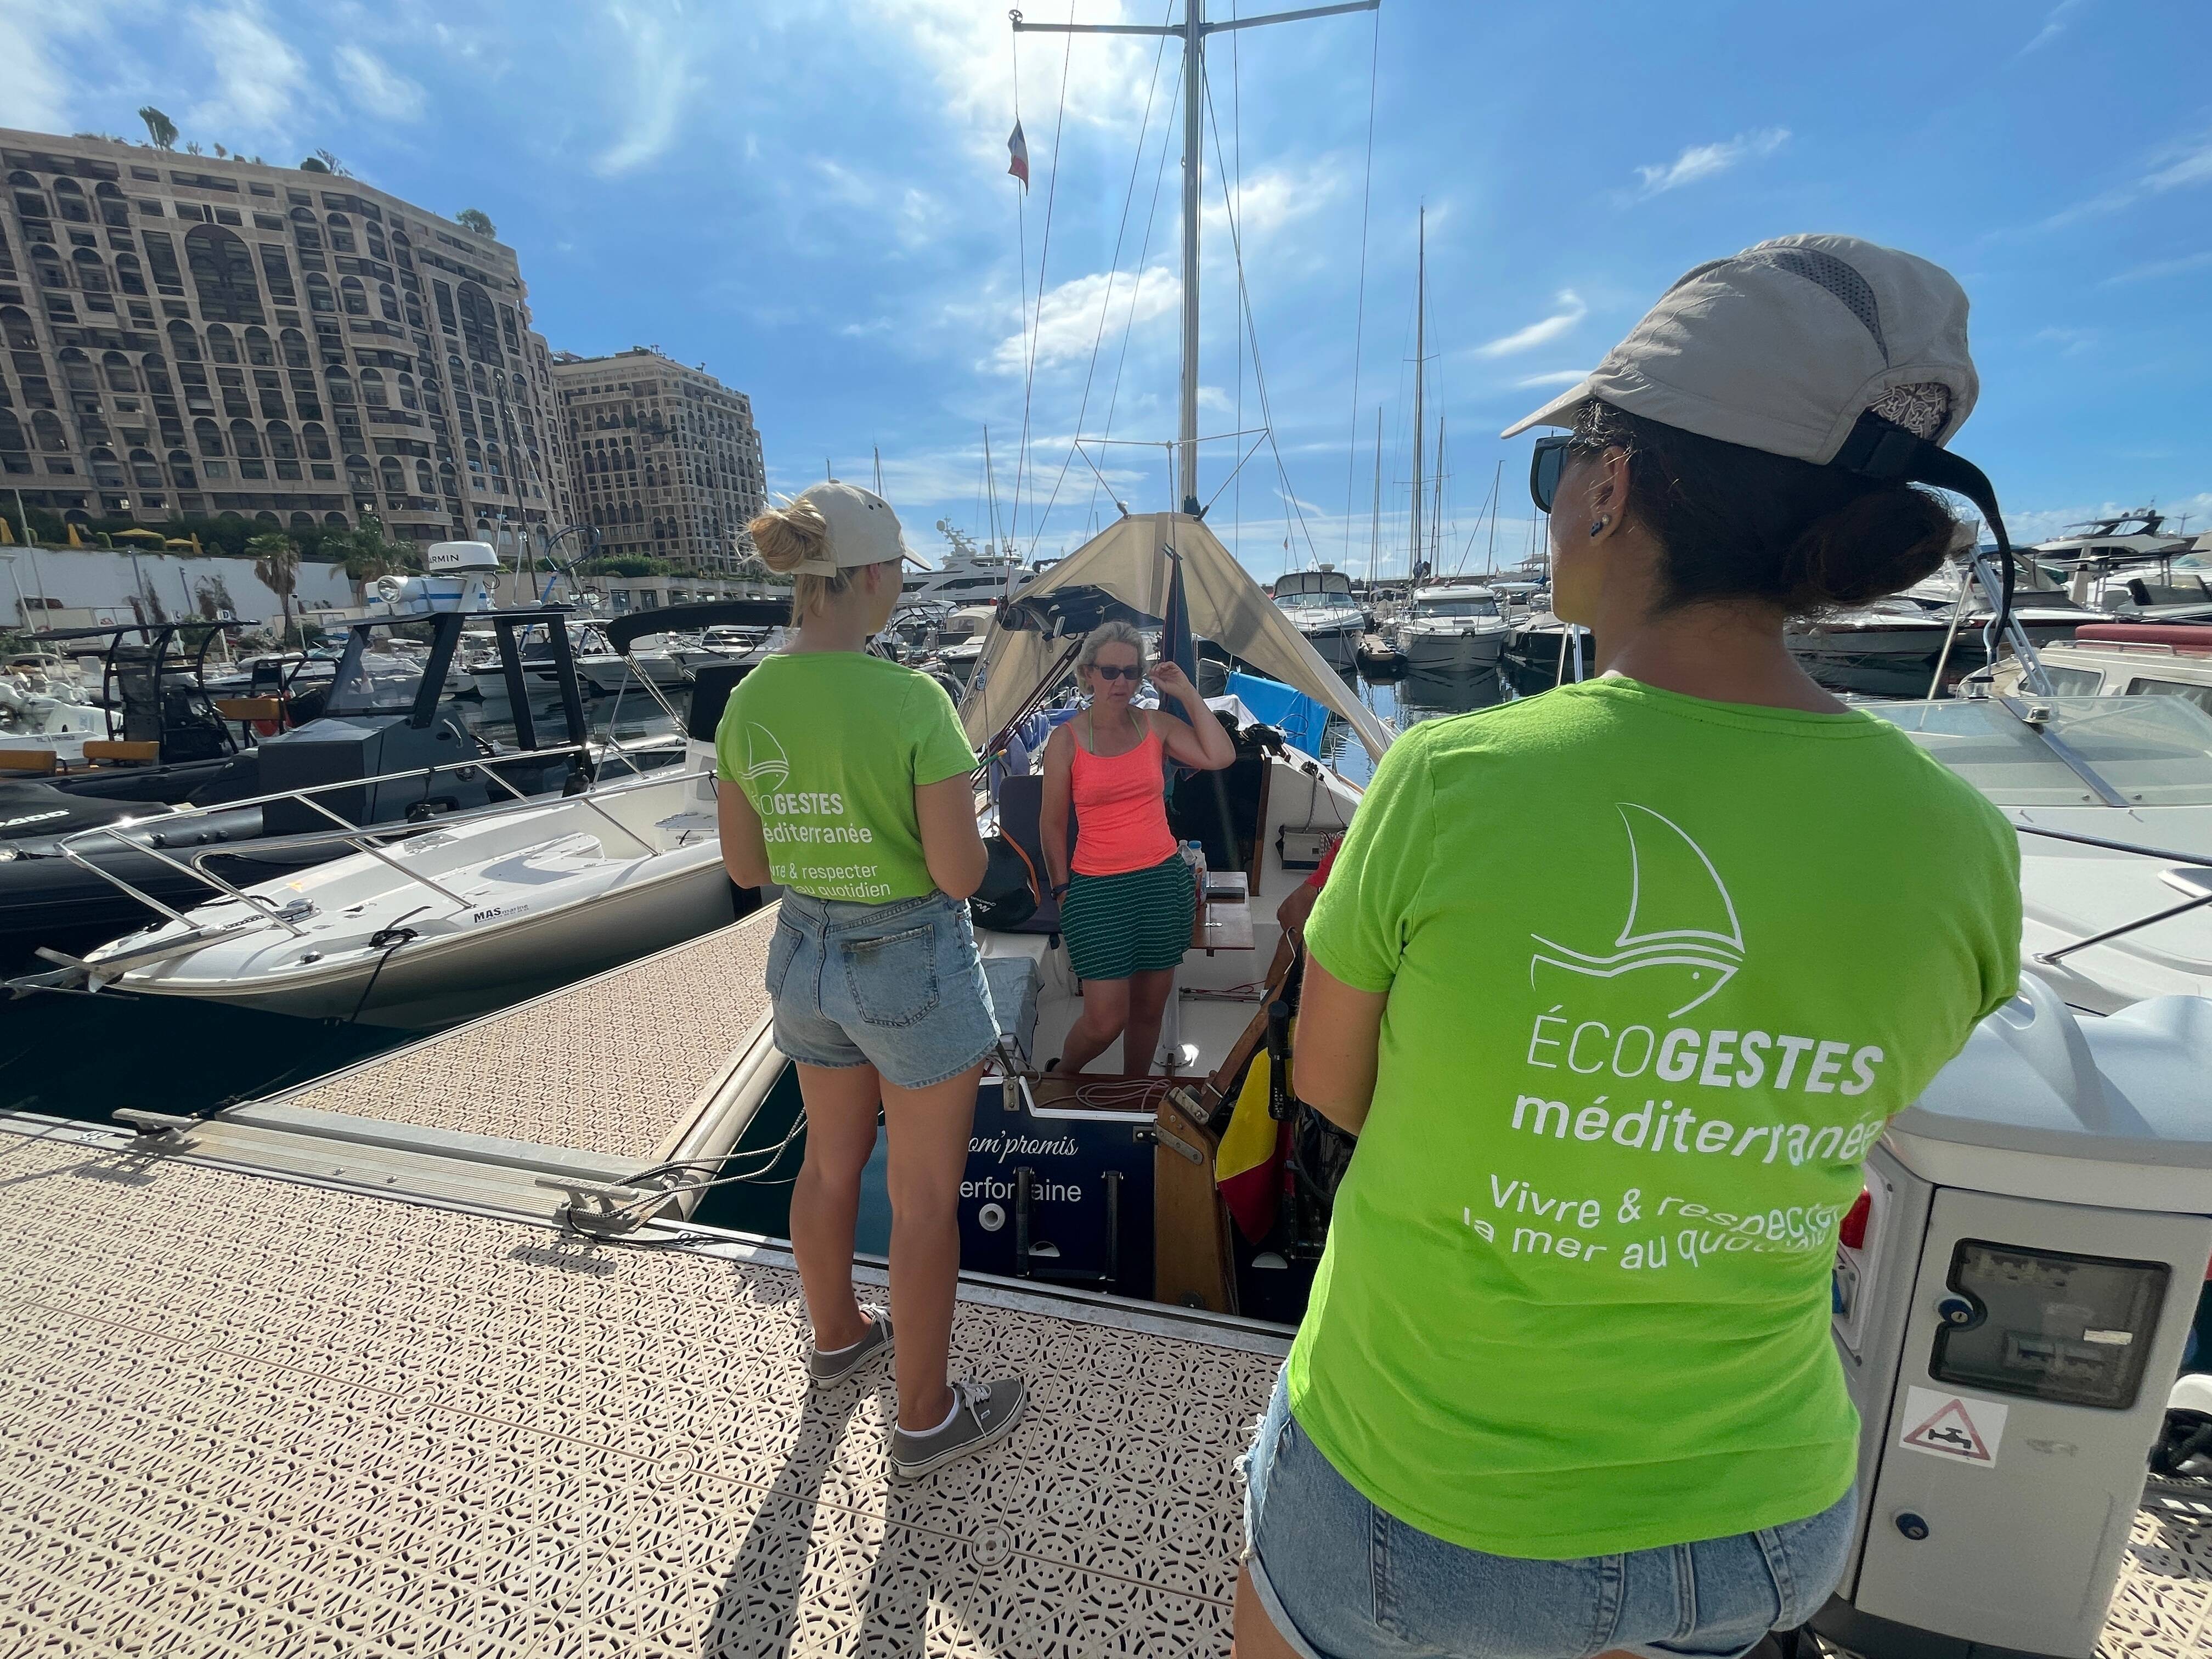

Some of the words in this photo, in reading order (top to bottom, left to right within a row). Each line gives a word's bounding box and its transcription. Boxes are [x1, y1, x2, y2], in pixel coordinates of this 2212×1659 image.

[763, 822, 873, 843] éditerranée
[789, 862, 799, 879] &
[802, 864, 878, 882] respecter
[817, 881, 891, 898] quotidien
[1526, 1004, 1884, 1096] ÉCOGESTES
[968, 1130, 1079, 1164] om'promis
[1490, 1173, 1601, 1229] Vivre
[1617, 1187, 1641, 1224] &
[1463, 1206, 1496, 1244] la
[1511, 1227, 1608, 1262] mer
[1620, 1235, 1668, 1270] au
